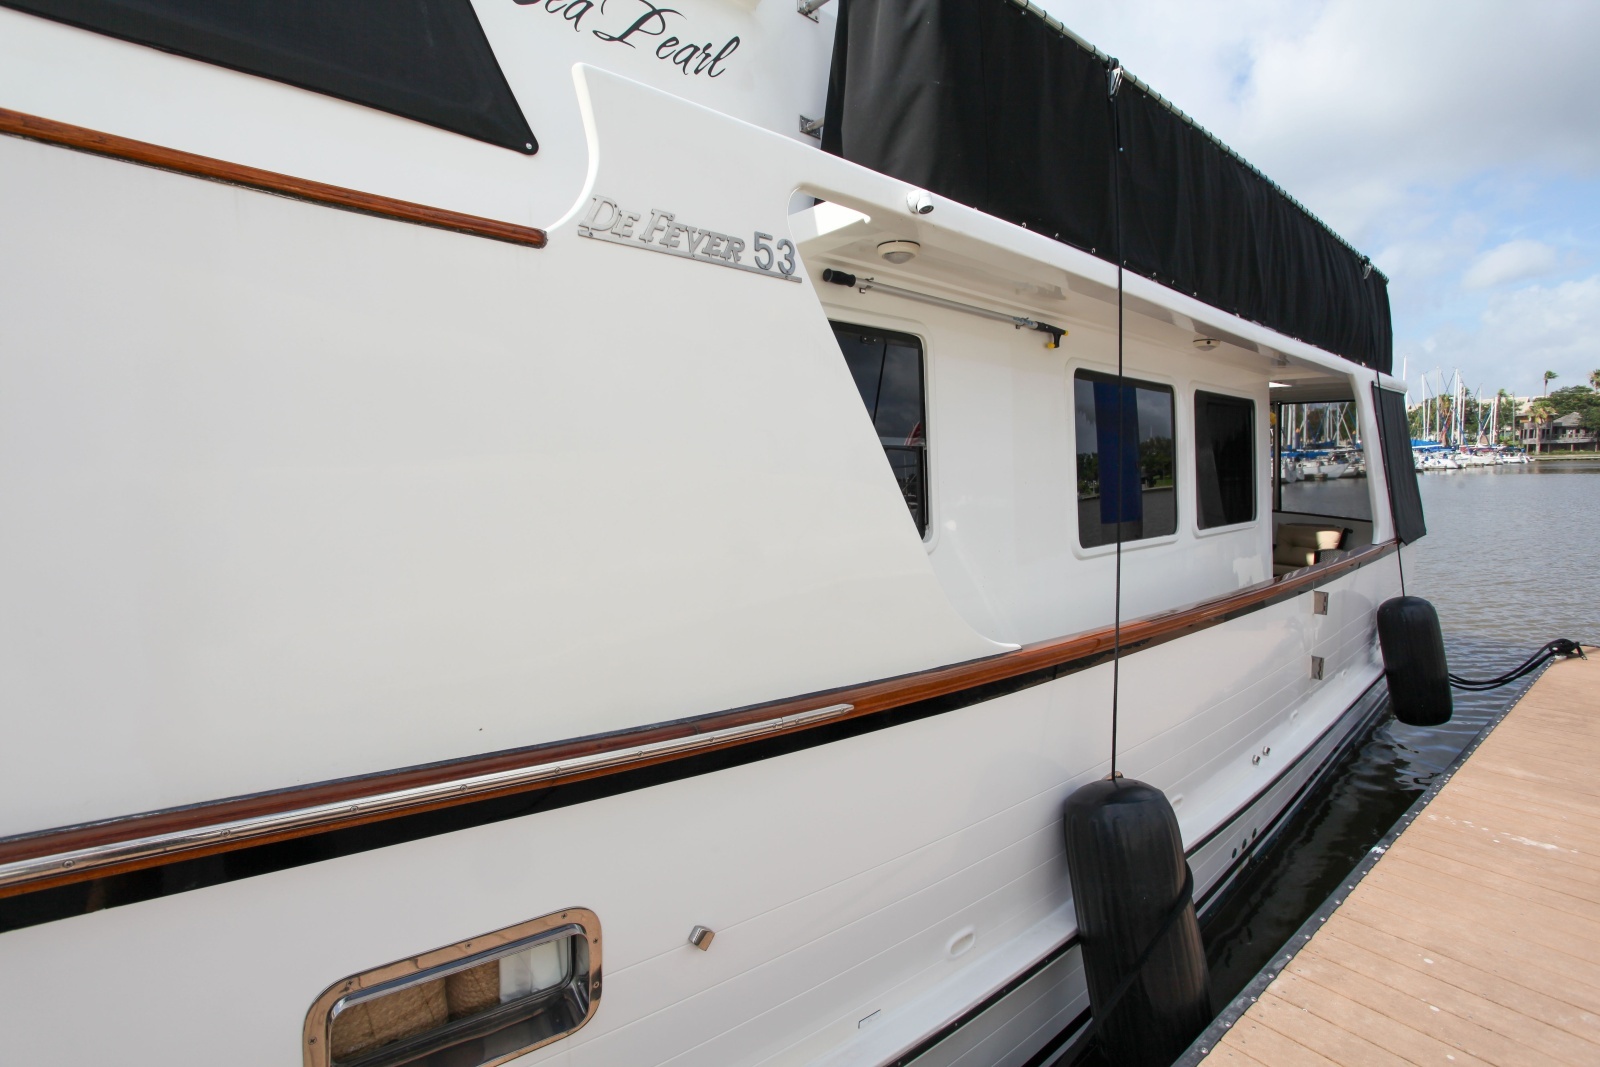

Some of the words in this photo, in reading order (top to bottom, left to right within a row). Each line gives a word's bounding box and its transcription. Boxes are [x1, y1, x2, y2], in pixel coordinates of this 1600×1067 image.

[512, 0, 594, 32] ea
[592, 0, 740, 77] Pearl
[753, 230, 796, 275] 53
